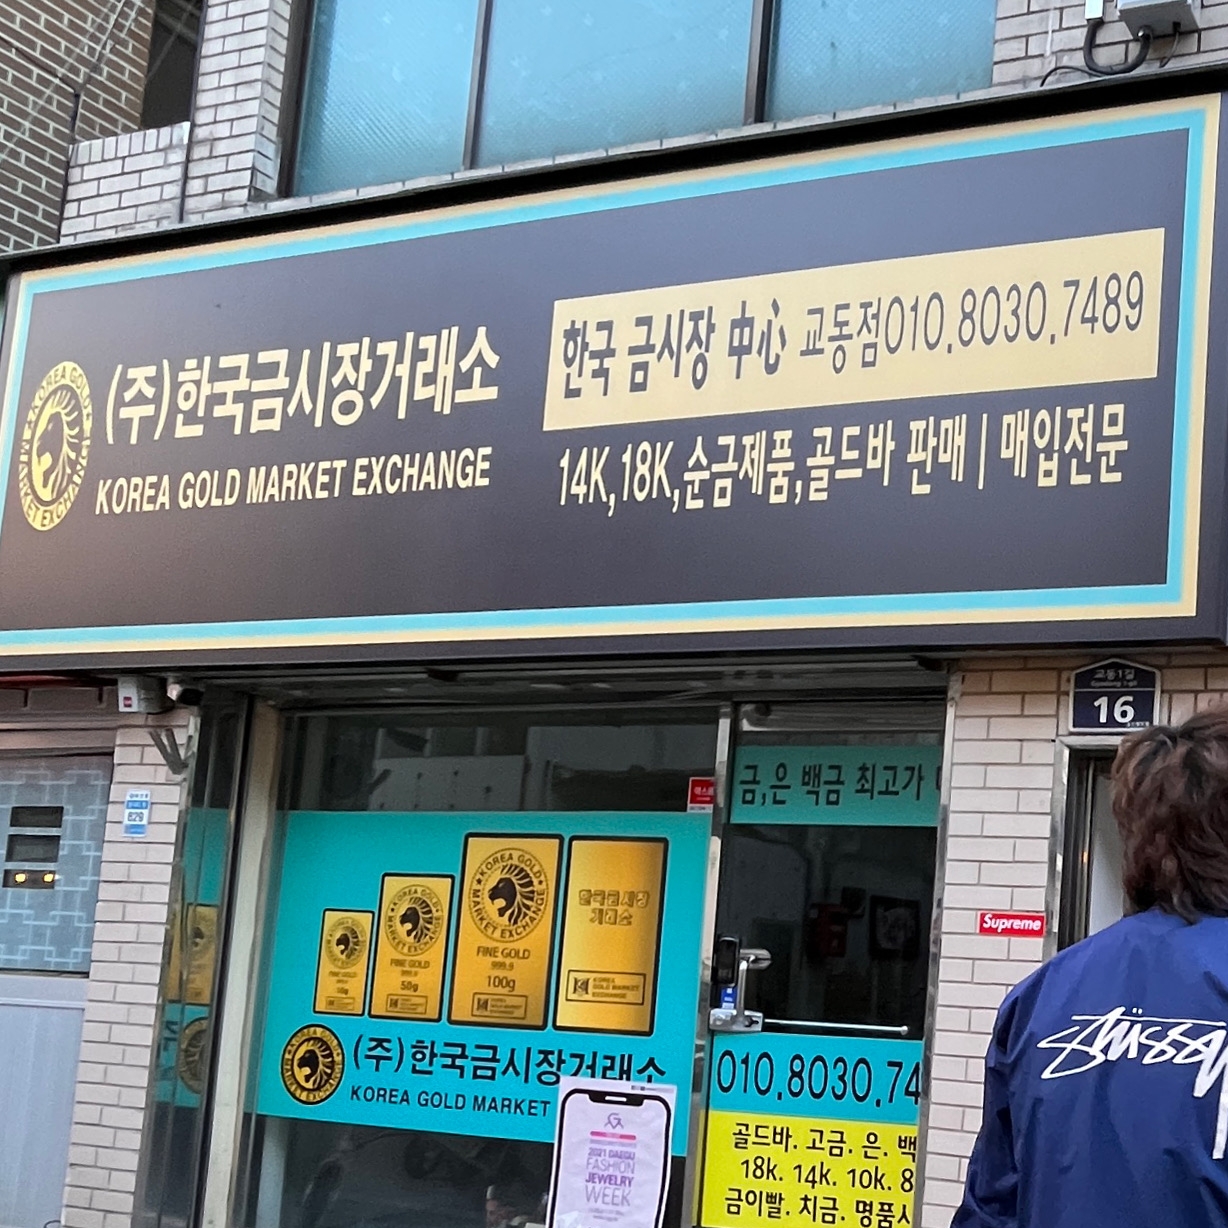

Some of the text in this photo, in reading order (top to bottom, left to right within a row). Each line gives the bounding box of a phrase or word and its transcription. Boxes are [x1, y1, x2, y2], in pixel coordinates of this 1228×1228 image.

[562, 319, 616, 399] 한국
[628, 304, 715, 393] 금시장
[728, 298, 787, 379] 中心
[105, 326, 500, 445] (주)한국금시장거래소
[907, 413, 966, 496] 판매
[999, 402, 1129, 488] 매입전문
[95, 445, 493, 516] KOREA GOLD MARKET EXCHANGE
[1093, 695, 1135, 723] 16
[739, 762, 792, 807] 금,은
[801, 763, 845, 807] 백금
[855, 762, 925, 801] 최고가
[479, 852, 543, 880] KOREA GOLD
[471, 888, 498, 936] MARKET
[982, 913, 1042, 933] Supreme
[476, 946, 531, 960] FINE GOLD
[486, 975, 516, 992] 100g
[350, 1085, 551, 1118] KOREA GOLD MARKET
[732, 1122, 797, 1153] 골드바.
[806, 1129, 853, 1157] 고금.
[585, 1172, 635, 1188] JEWELRY
[586, 1157, 636, 1175] FASHION
[585, 1184, 632, 1207] WEEK
